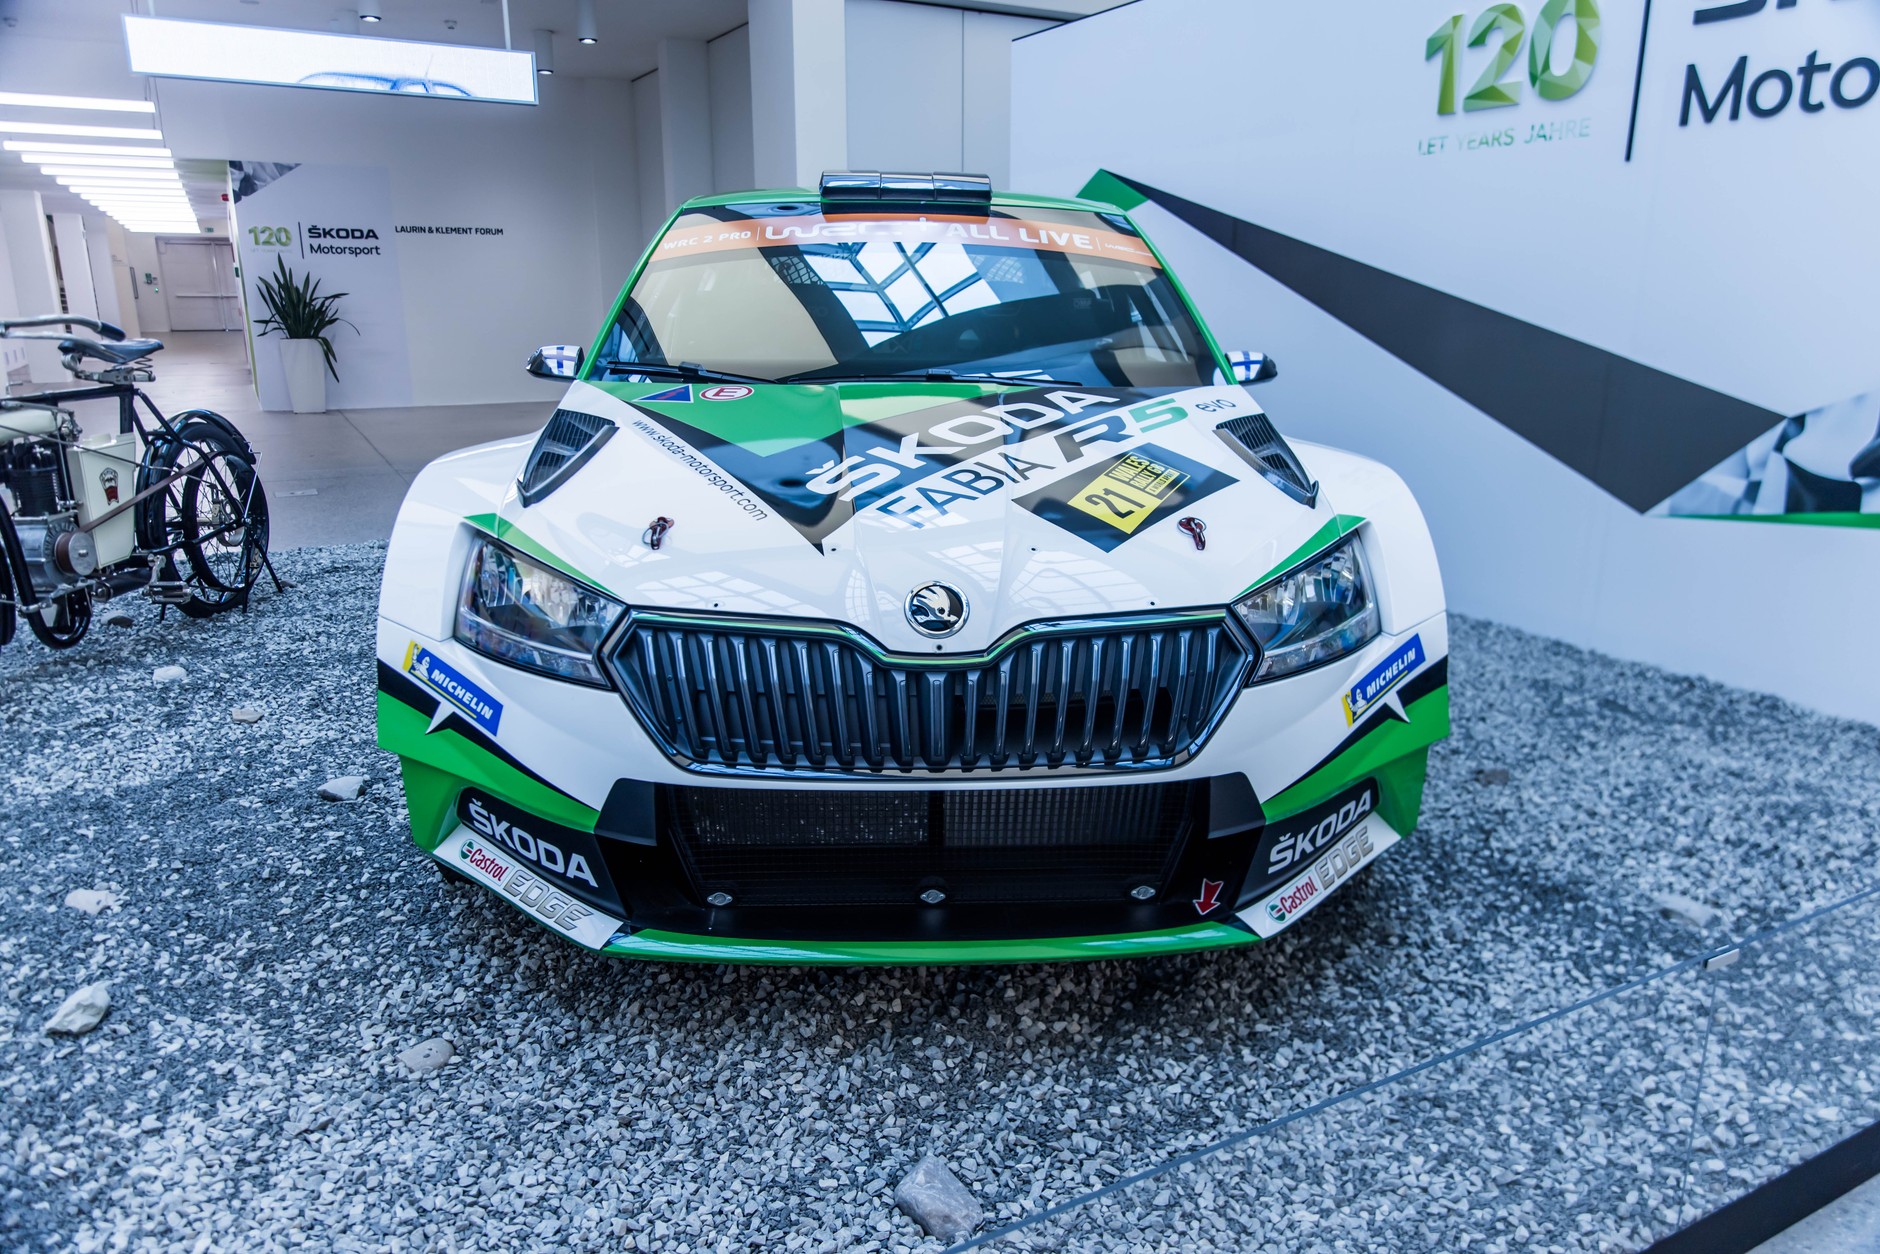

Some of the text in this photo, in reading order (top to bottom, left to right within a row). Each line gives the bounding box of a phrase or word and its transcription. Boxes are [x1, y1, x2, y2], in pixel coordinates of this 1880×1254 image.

[1425, 0, 1600, 115] 120
[1418, 118, 1592, 156] LET YEARS JAHRE
[248, 226, 292, 246] 120
[307, 225, 380, 240] ŠKODA
[309, 243, 381, 257] Motorsport
[395, 225, 504, 236] LAURIN & KLEMENT FORUM
[663, 231, 752, 250] WRC 2 PRO
[948, 223, 1010, 241] ALL
[1019, 227, 1094, 250] LIVE
[805, 390, 1120, 502] ŠKODA
[875, 397, 1237, 530] FABIA R5 evo
[632, 419, 768, 522] www.skoda-motorsport.com
[1108, 455, 1150, 482] WALES
[1129, 471, 1157, 489] RALLY
[1084, 487, 1146, 519] 21
[430, 669, 494, 720] MICHELIN
[1366, 647, 1416, 699] MICHELIN
[468, 797, 599, 889] ŠKODA
[1267, 788, 1372, 875] ŠKODA
[469, 847, 595, 932] Castrol EDGE
[1280, 824, 1374, 914] Castrol EDGE
